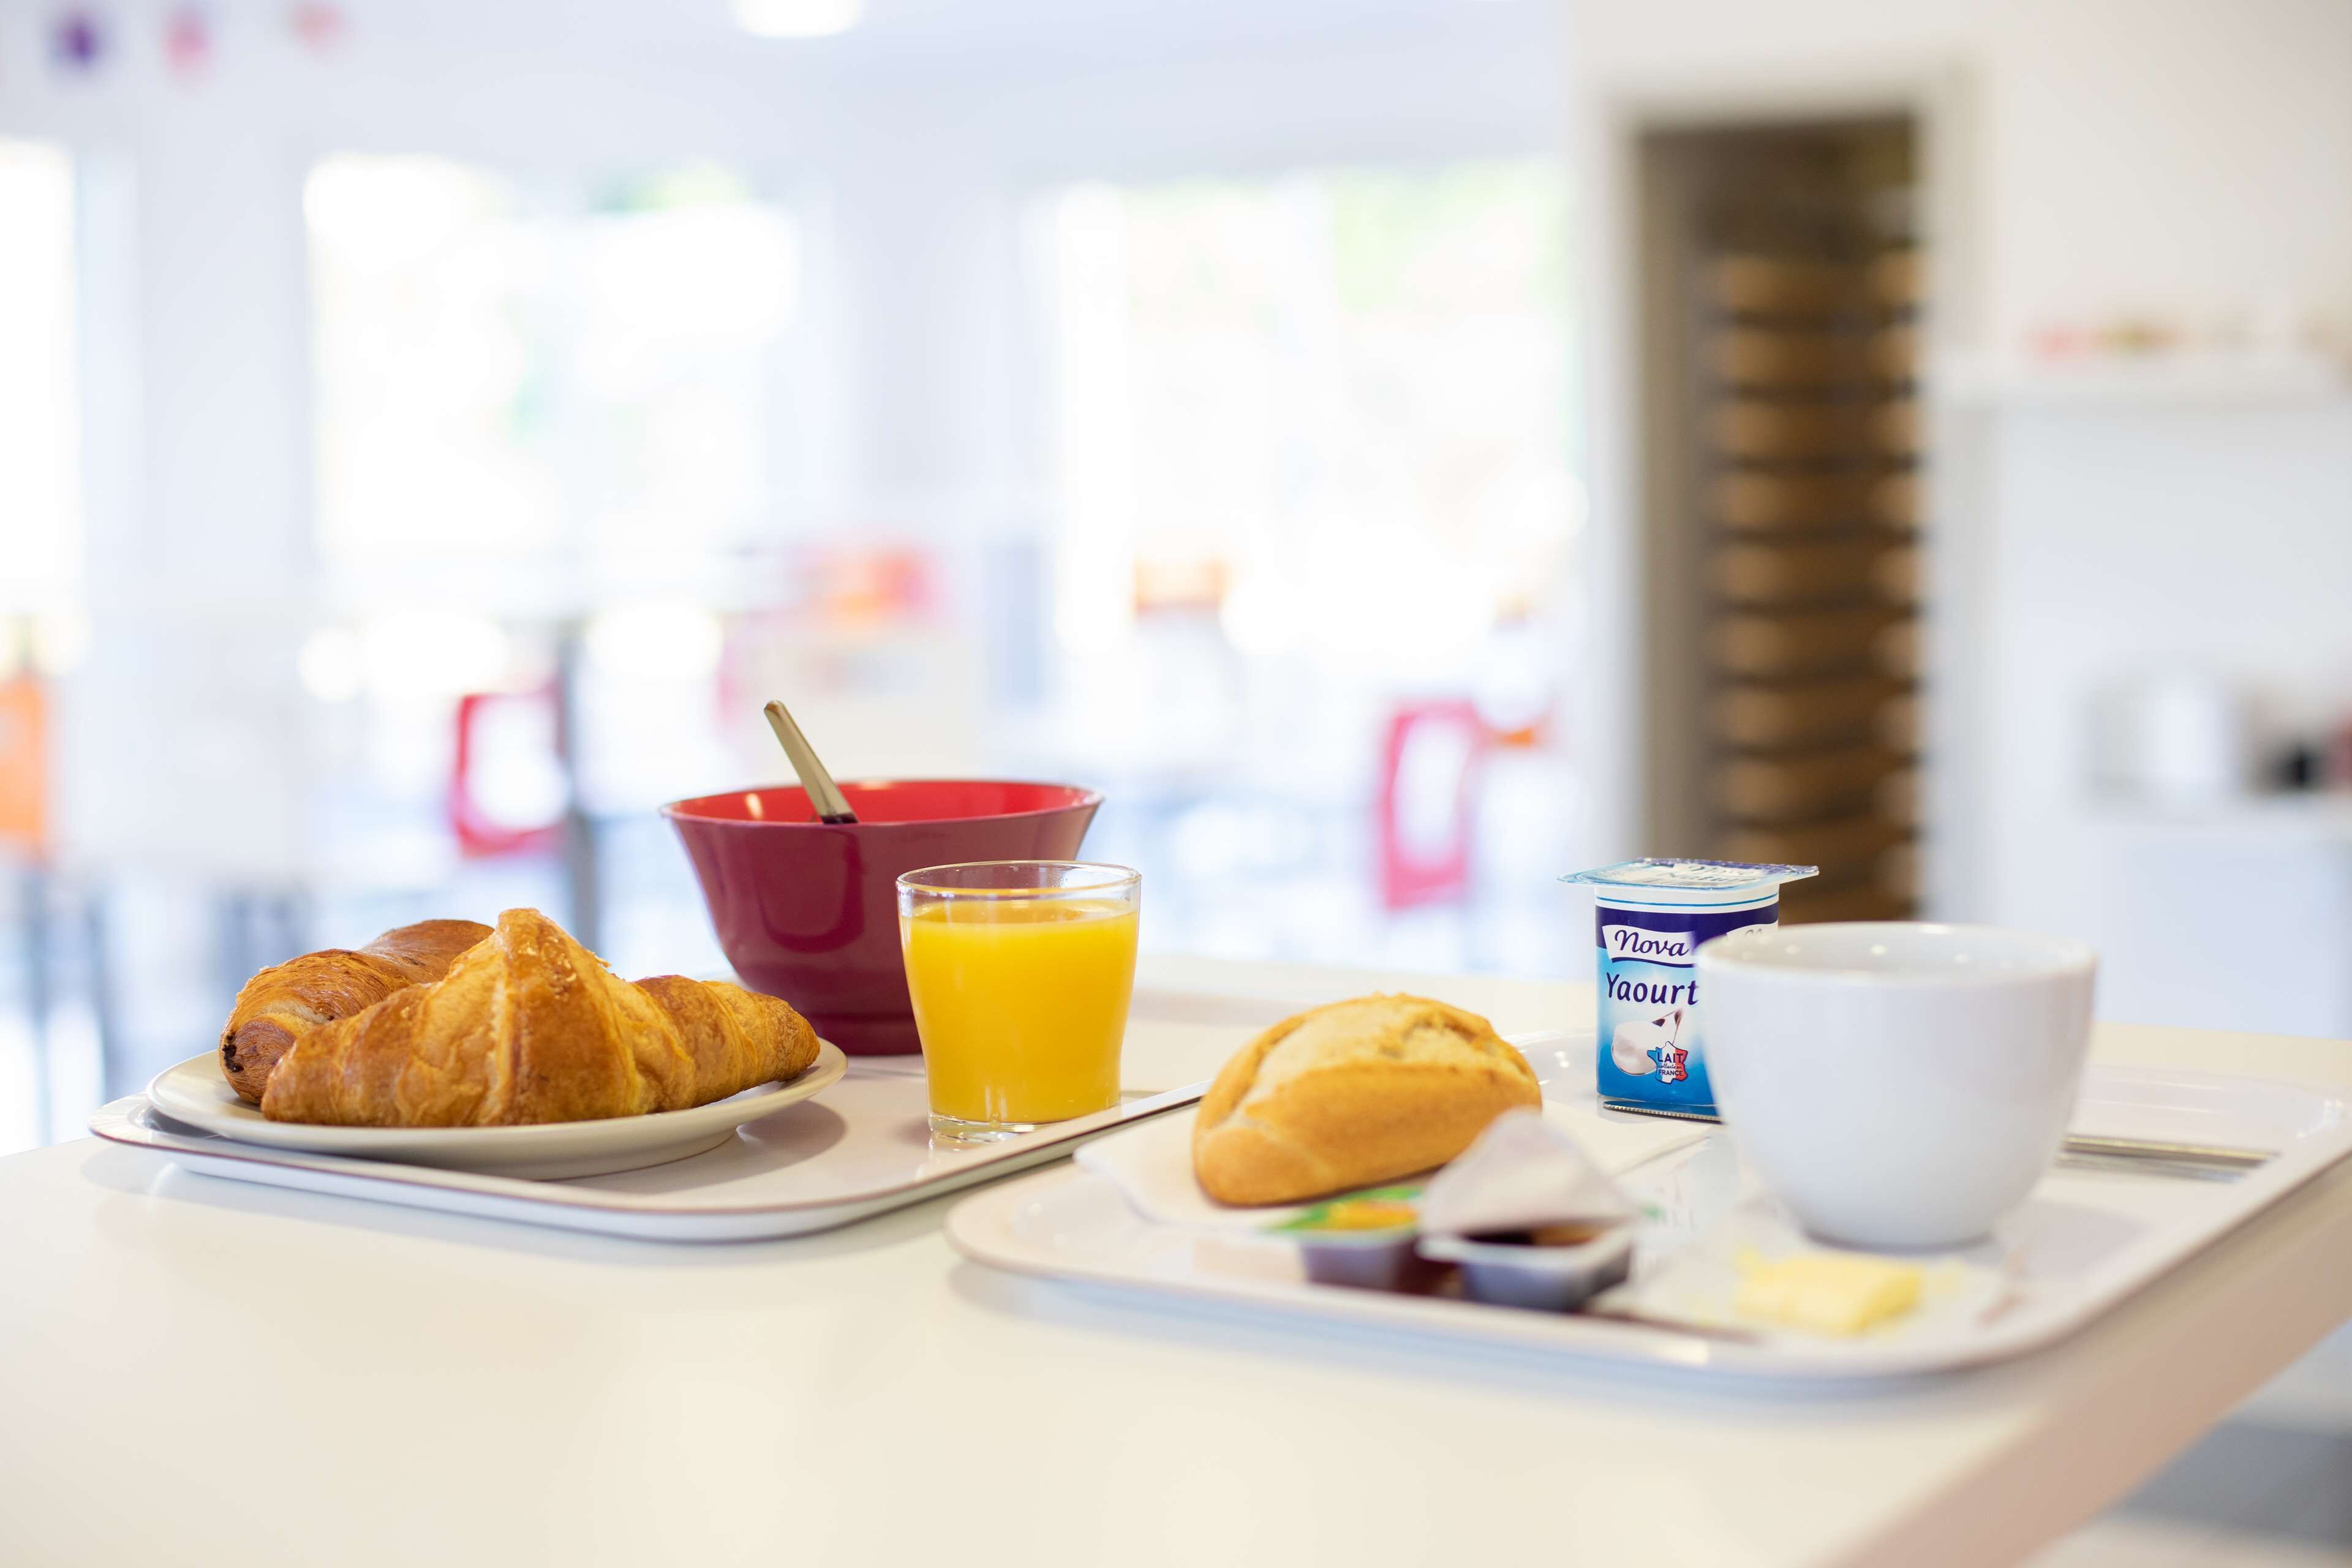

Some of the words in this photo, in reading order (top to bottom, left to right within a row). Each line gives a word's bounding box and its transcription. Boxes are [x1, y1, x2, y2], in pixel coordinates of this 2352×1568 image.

[1615, 930, 1689, 956] Nova
[1606, 972, 1700, 1005] Yaourt
[1657, 1052, 1683, 1063] LAIT
